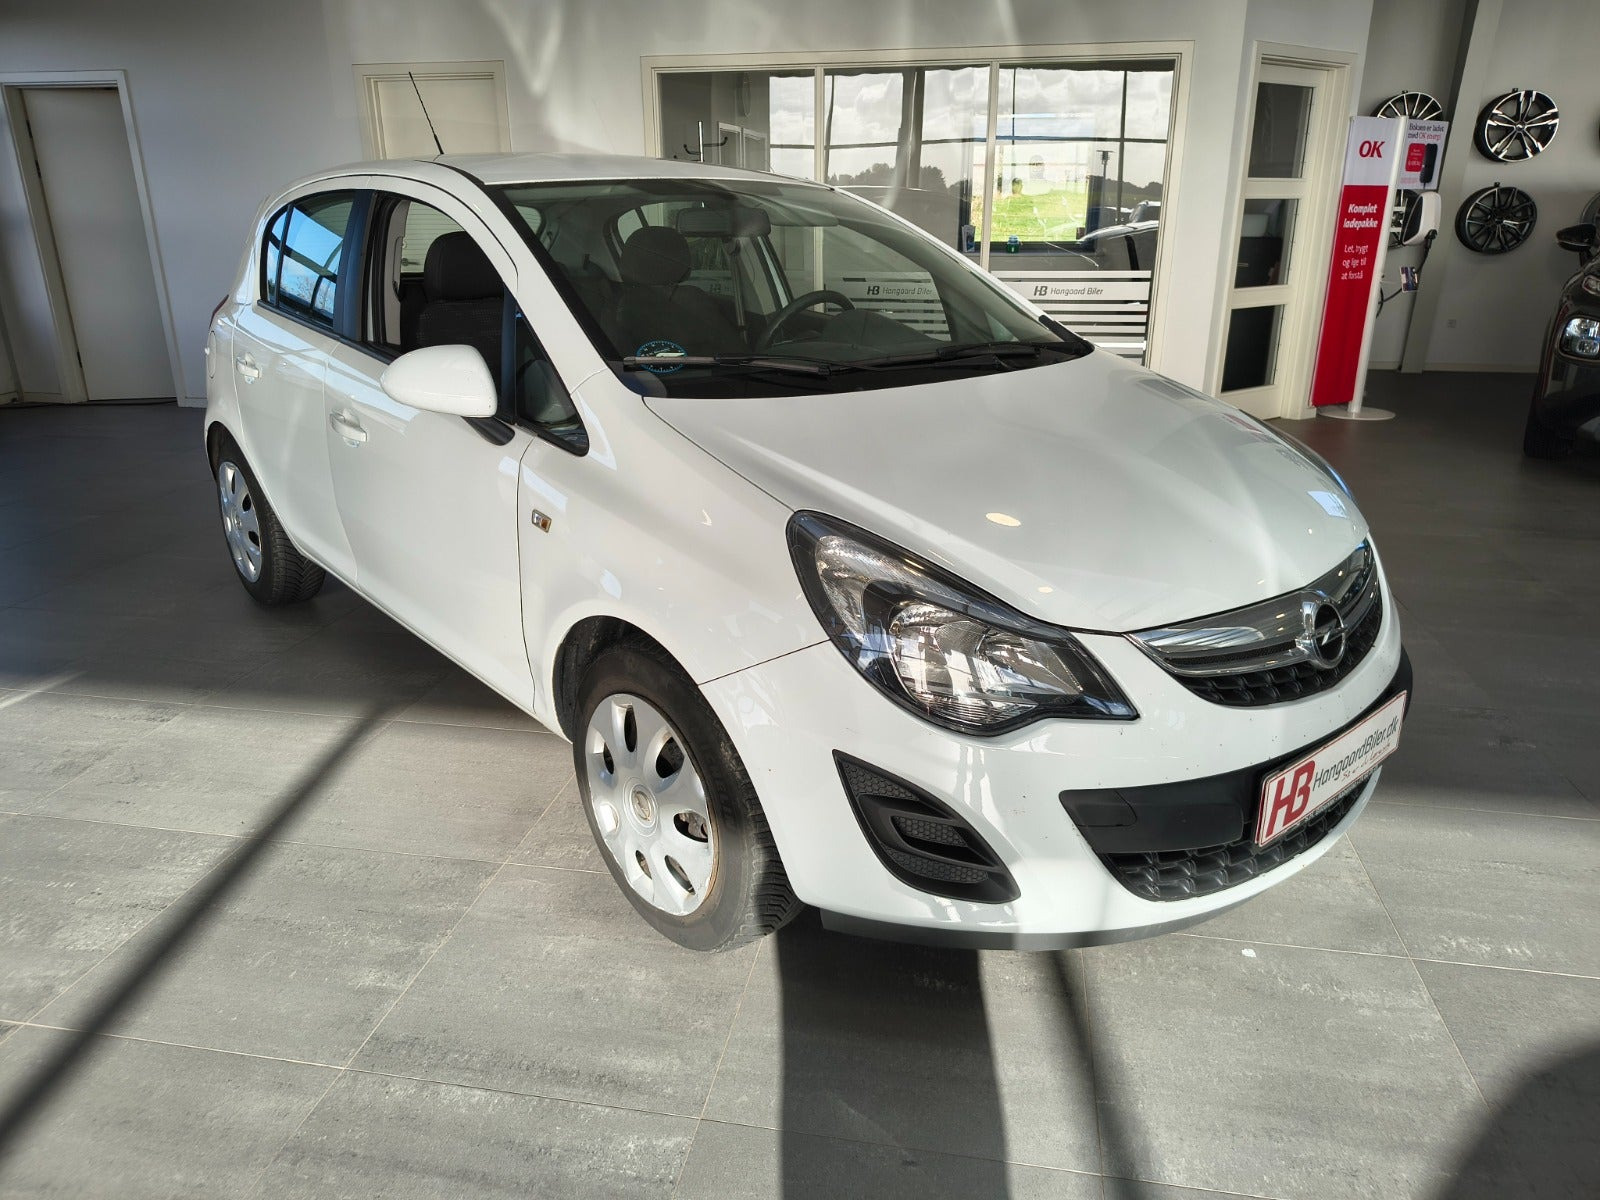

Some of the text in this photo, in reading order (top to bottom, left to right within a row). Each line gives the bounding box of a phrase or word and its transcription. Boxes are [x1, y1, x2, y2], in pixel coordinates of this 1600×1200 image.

[1359, 140, 1385, 158] OK
[1348, 203, 1377, 215] Komplet
[1343, 218, 1378, 230] ladepakke
[1344, 244, 1354, 253] Let,
[1342, 259, 1350, 268] og
[1341, 270, 1363, 280] at forstå
[866, 285, 880, 295] HB
[883, 287, 916, 296] Hangaard
[1033, 285, 1103, 296] HB Hangaard Biler
[1265, 760, 1316, 837] HB
[1312, 715, 1400, 791] HangaardBiler.dk
